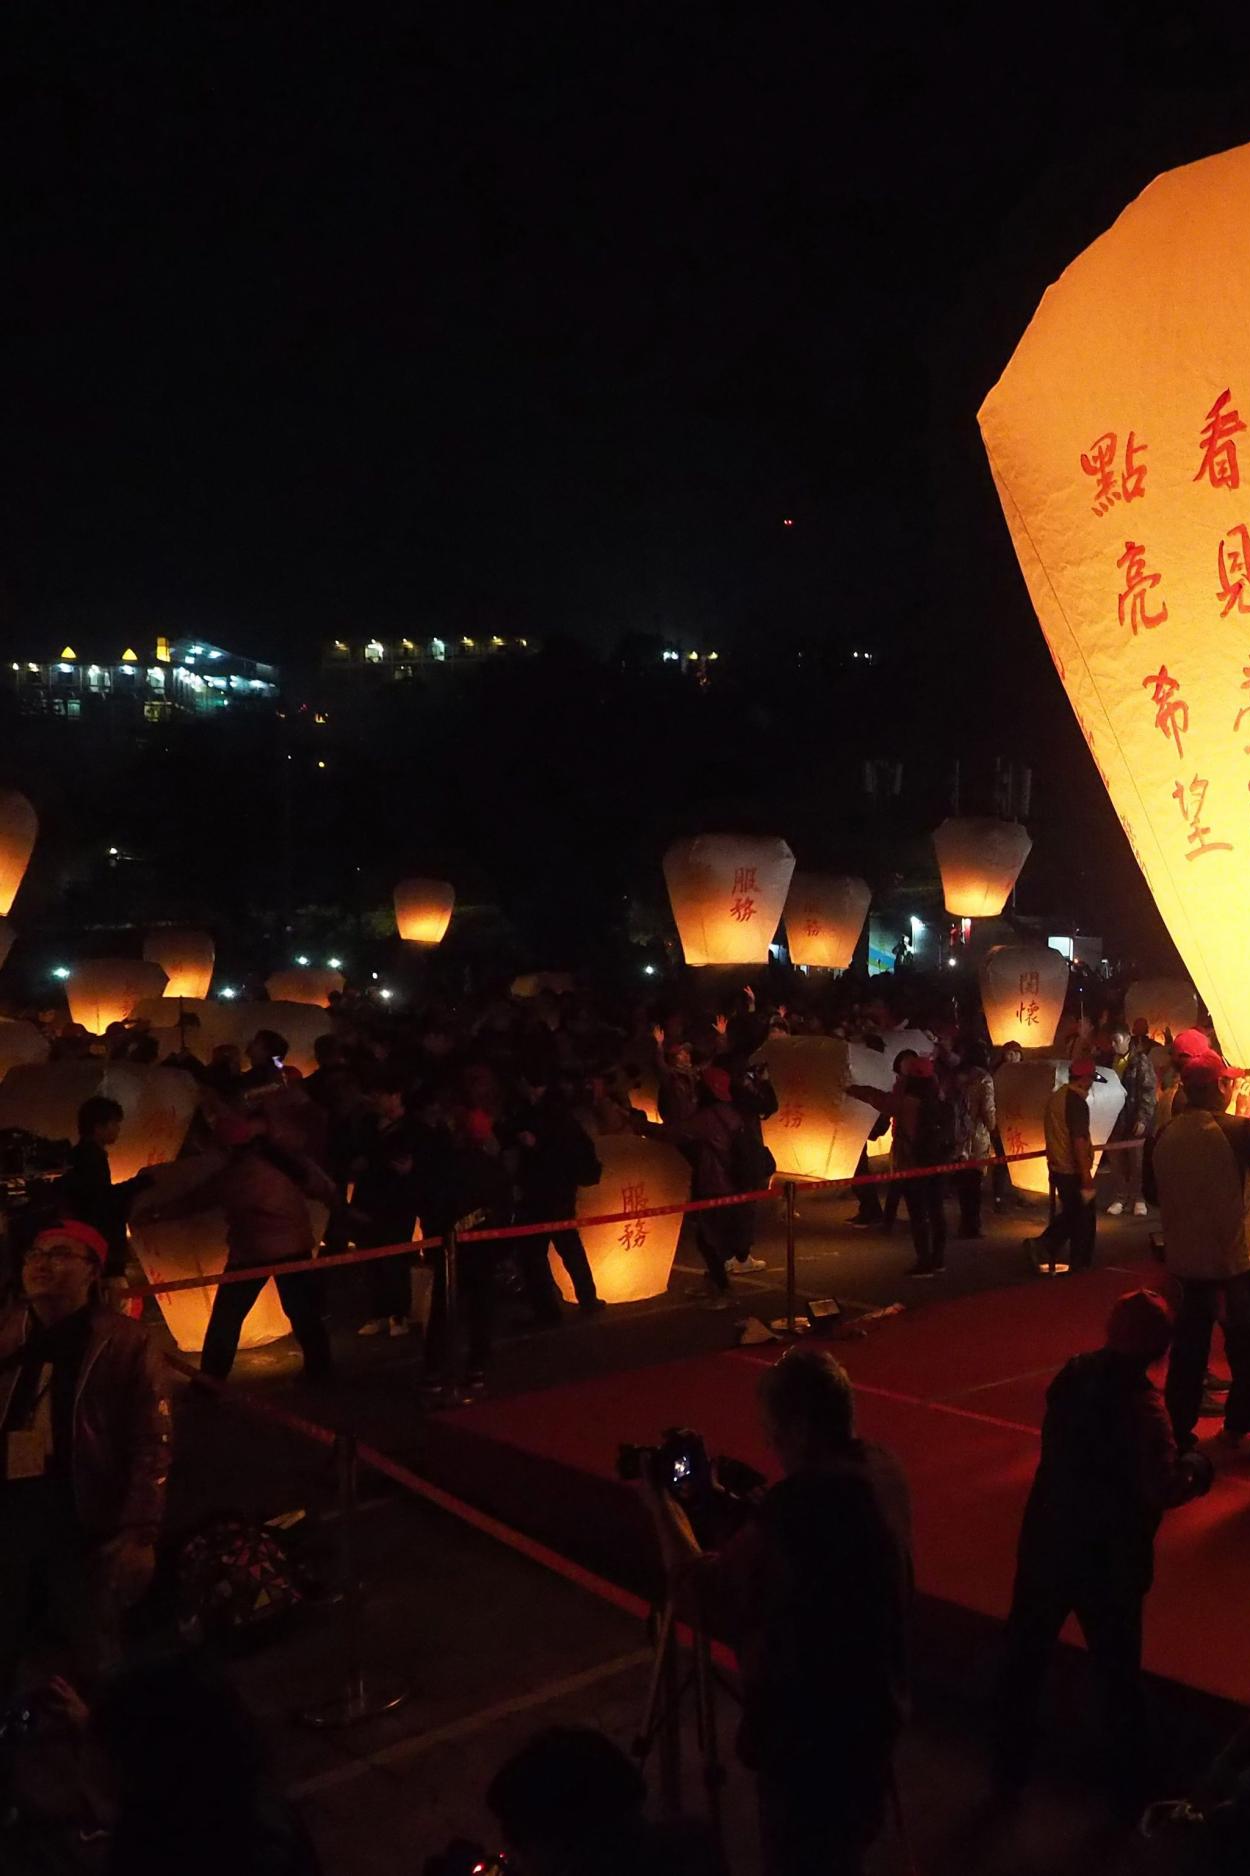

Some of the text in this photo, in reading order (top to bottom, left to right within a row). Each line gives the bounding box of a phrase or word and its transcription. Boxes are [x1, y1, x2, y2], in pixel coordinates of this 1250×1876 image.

[1080, 431, 1233, 862] 點亮希望
[730, 866, 762, 923] 服務
[618, 1181, 650, 1252] 服務
